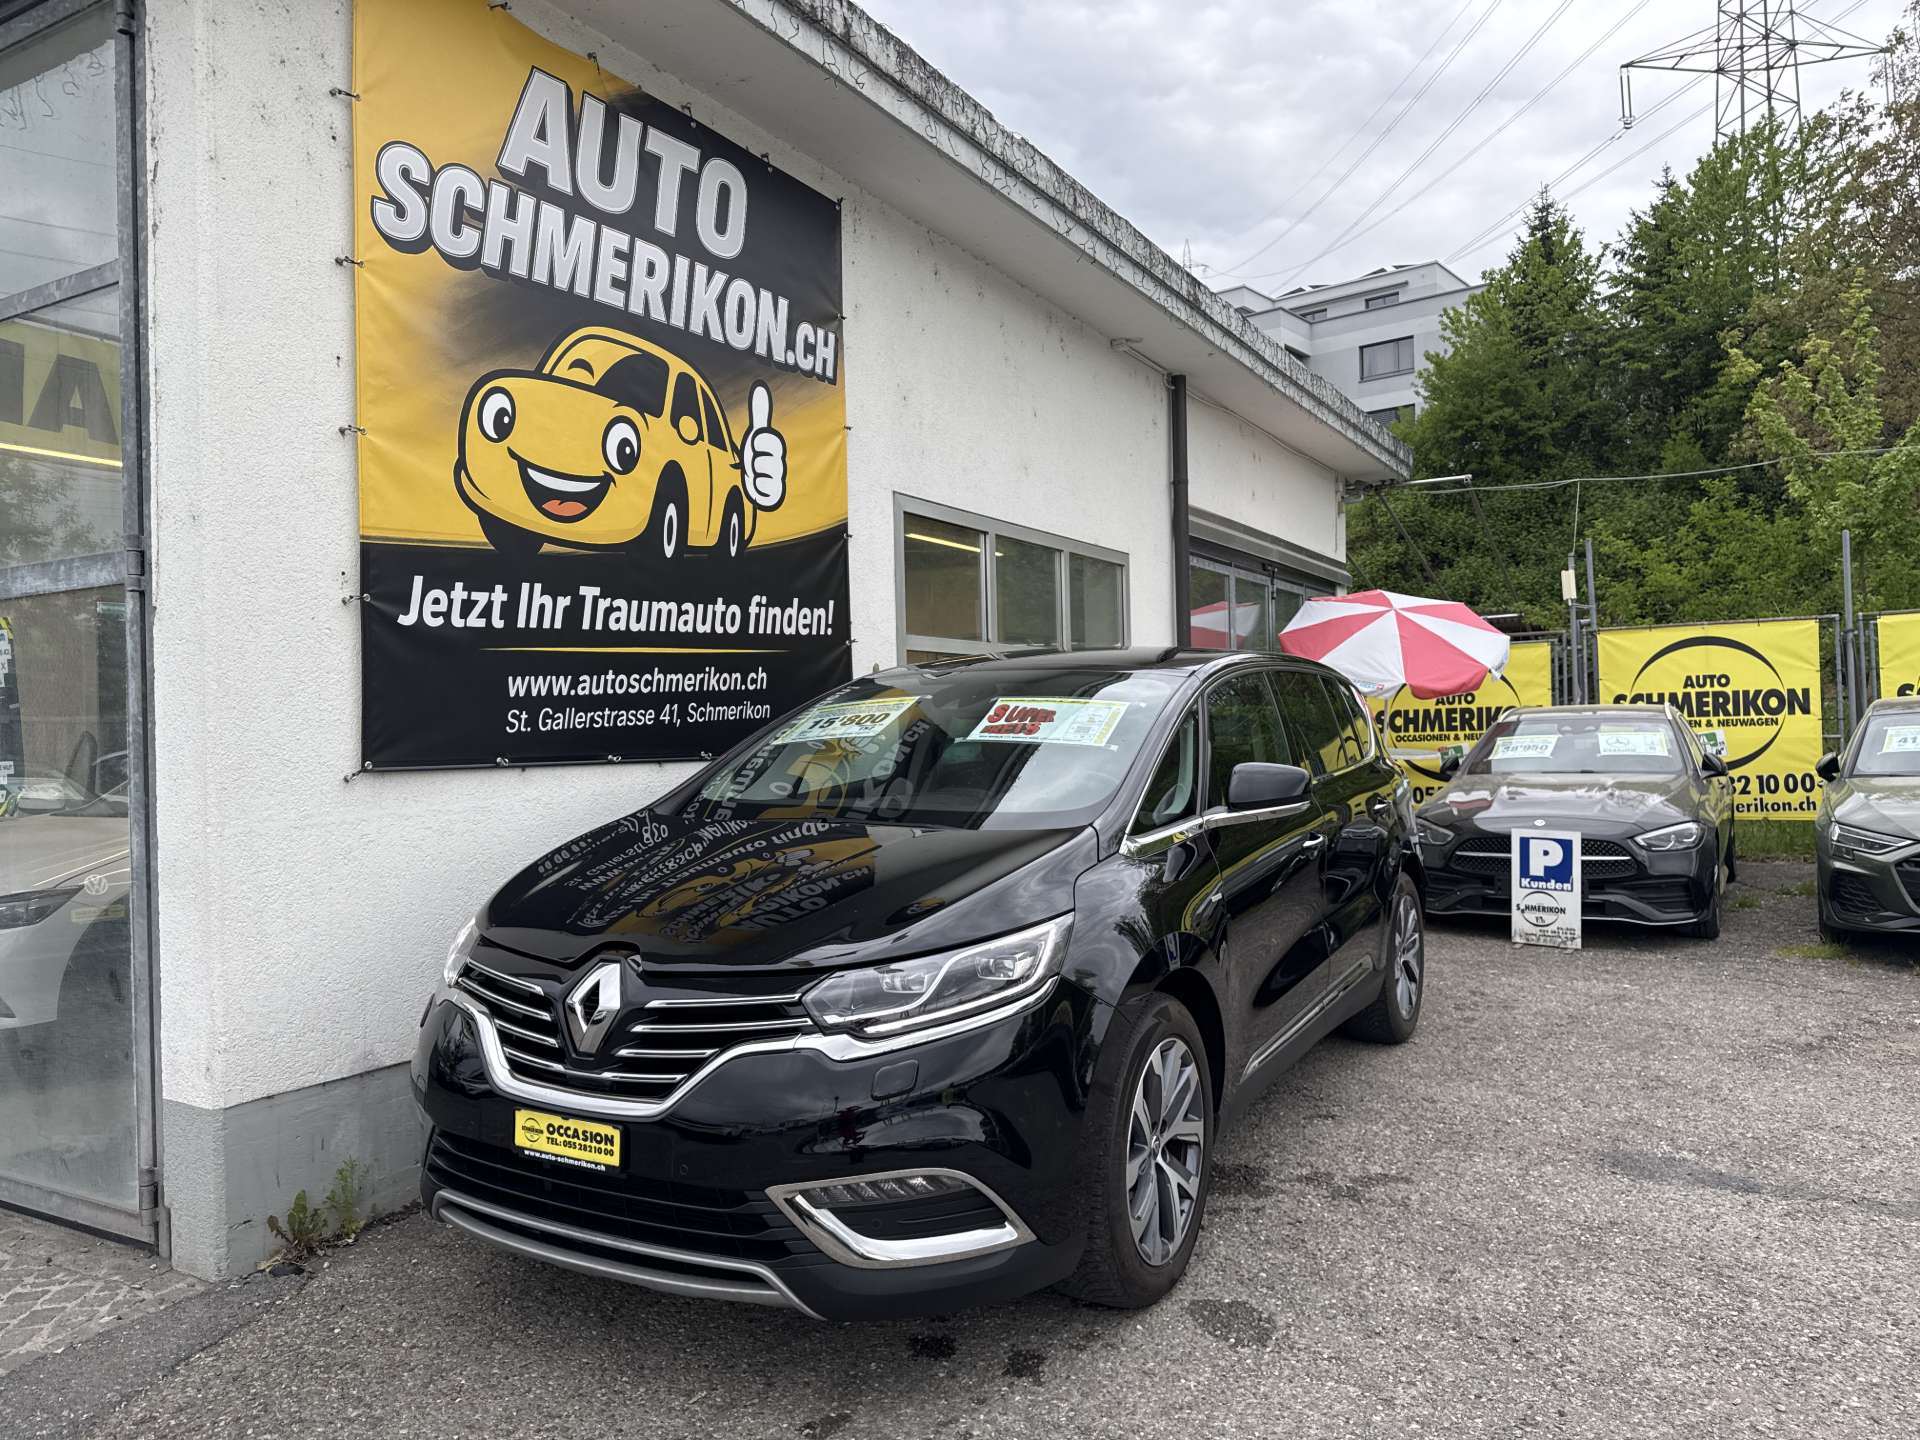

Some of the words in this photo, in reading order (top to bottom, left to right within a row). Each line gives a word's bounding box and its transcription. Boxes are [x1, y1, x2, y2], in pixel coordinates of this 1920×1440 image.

[499, 66, 748, 260] AUTO
[373, 142, 837, 381] SCHMERIKON.CH
[398, 575, 505, 629] Jetzt
[516, 582, 571, 629] Ihr
[579, 585, 741, 635] Traumauto
[748, 595, 834, 636] finden!
[508, 667, 768, 697] www.autoschmerikon.ch
[1682, 673, 1731, 689] AUTO
[1435, 692, 1476, 706] AUTO
[506, 708, 532, 733] St.
[538, 704, 656, 732] Gallerstrasse
[659, 703, 681, 728] 41,
[687, 700, 771, 723] Schmerikon
[1706, 719, 1716, 728] &
[1717, 717, 1779, 728] NEUWAGEN
[1395, 733, 1451, 743] OCCASIONEN
[1453, 733, 1461, 741] &
[1755, 774, 1780, 794] 10
[1783, 773, 1816, 794] 00
[1735, 796, 1817, 813] erikon.ch
[1528, 838, 1564, 877] P
[1520, 877, 1572, 891] Kunden
[546, 1123, 614, 1147] OCCASION
[546, 1136, 561, 1146] TEL:
[562, 1140, 576, 1149] 055
